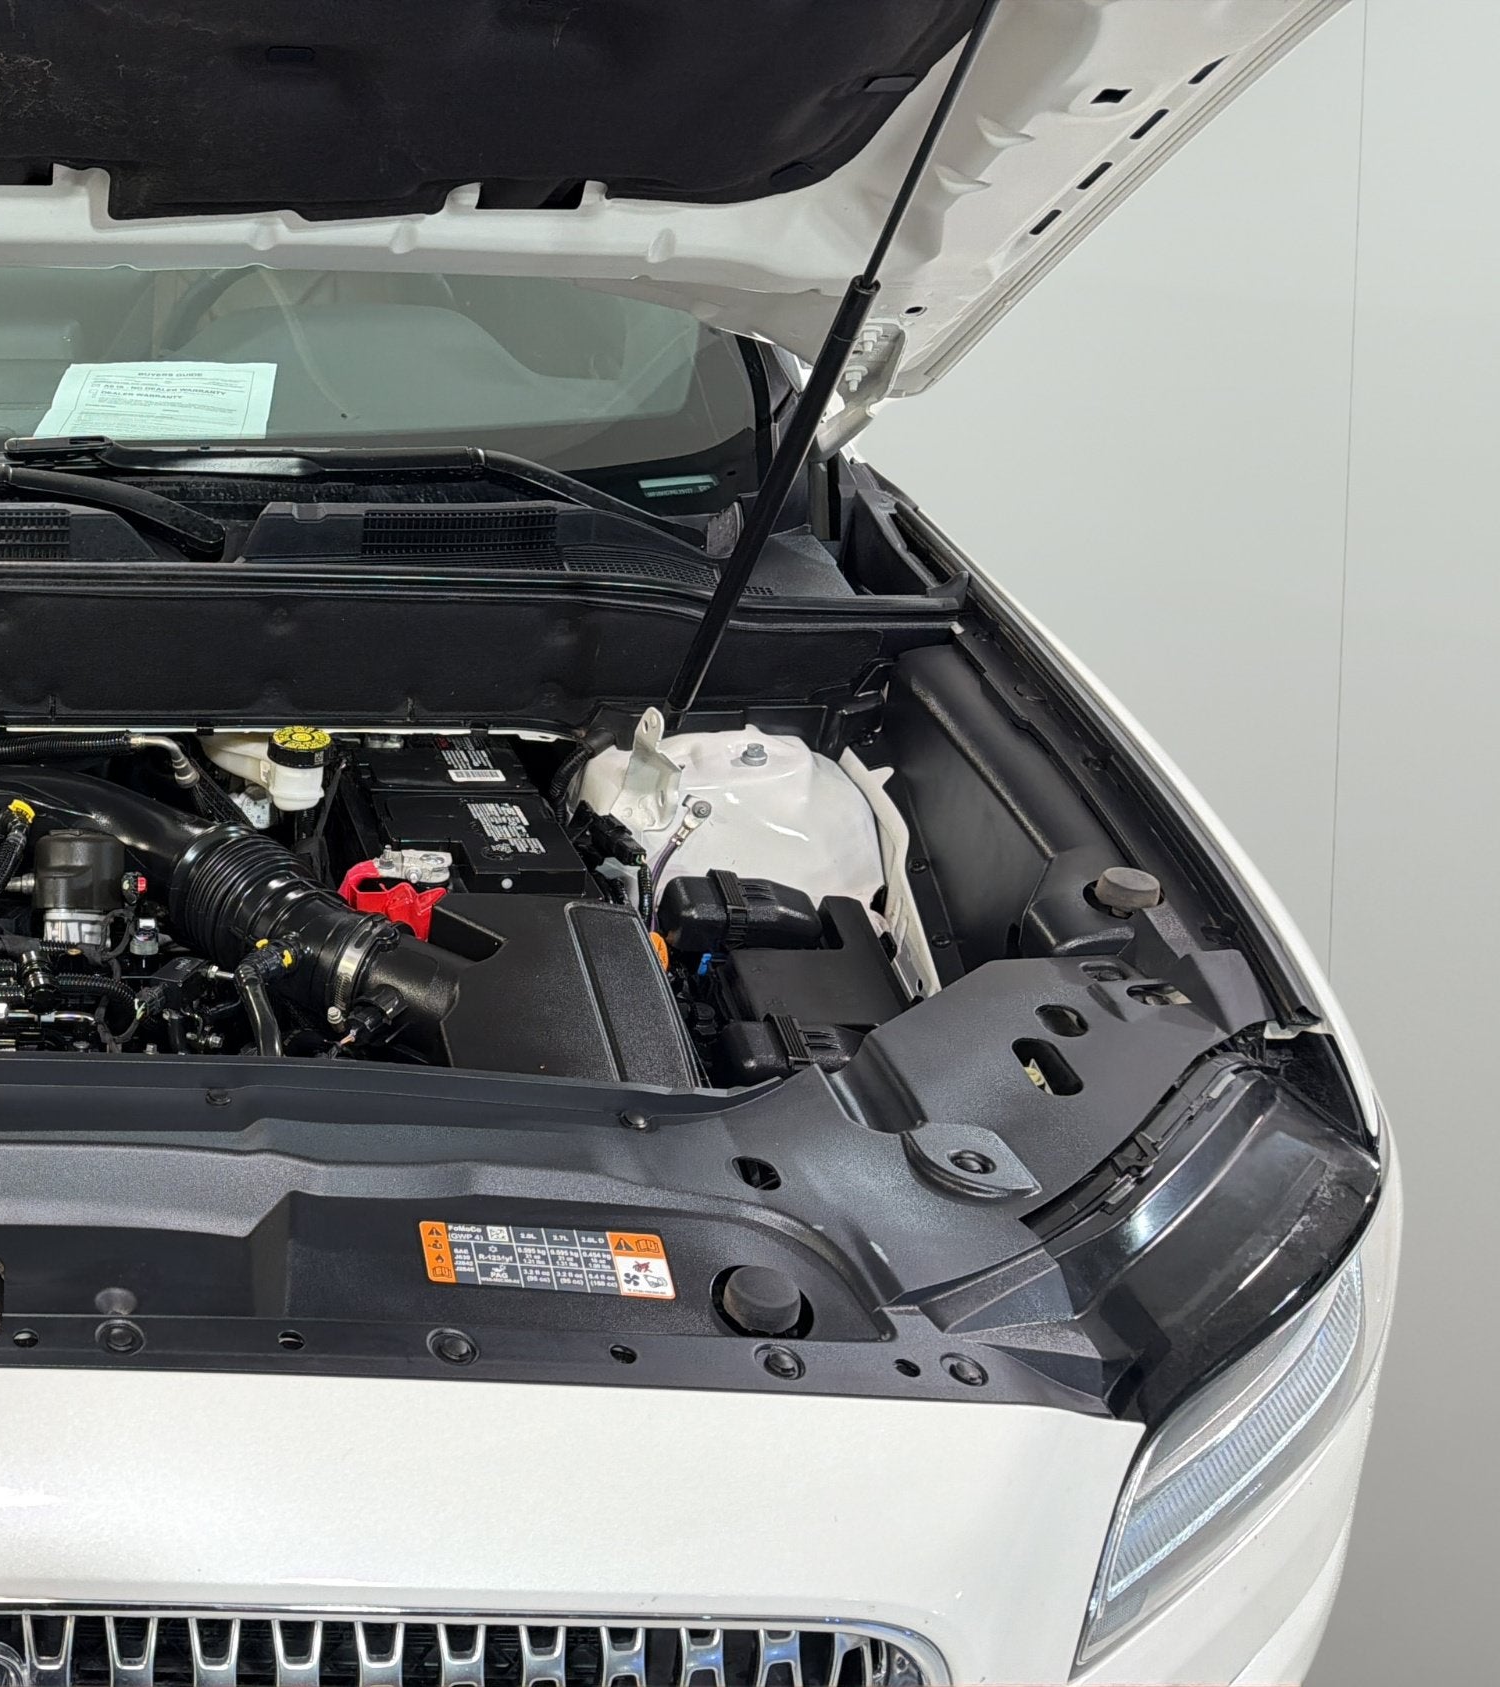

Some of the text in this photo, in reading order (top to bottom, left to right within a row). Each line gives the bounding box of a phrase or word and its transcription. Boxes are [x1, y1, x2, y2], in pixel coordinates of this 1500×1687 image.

[179, 388, 227, 396] WARRANTY
[447, 1225, 482, 1233] FoMoCo
[448, 1232, 473, 1241] (GWP
[490, 1271, 509, 1279] PAG
